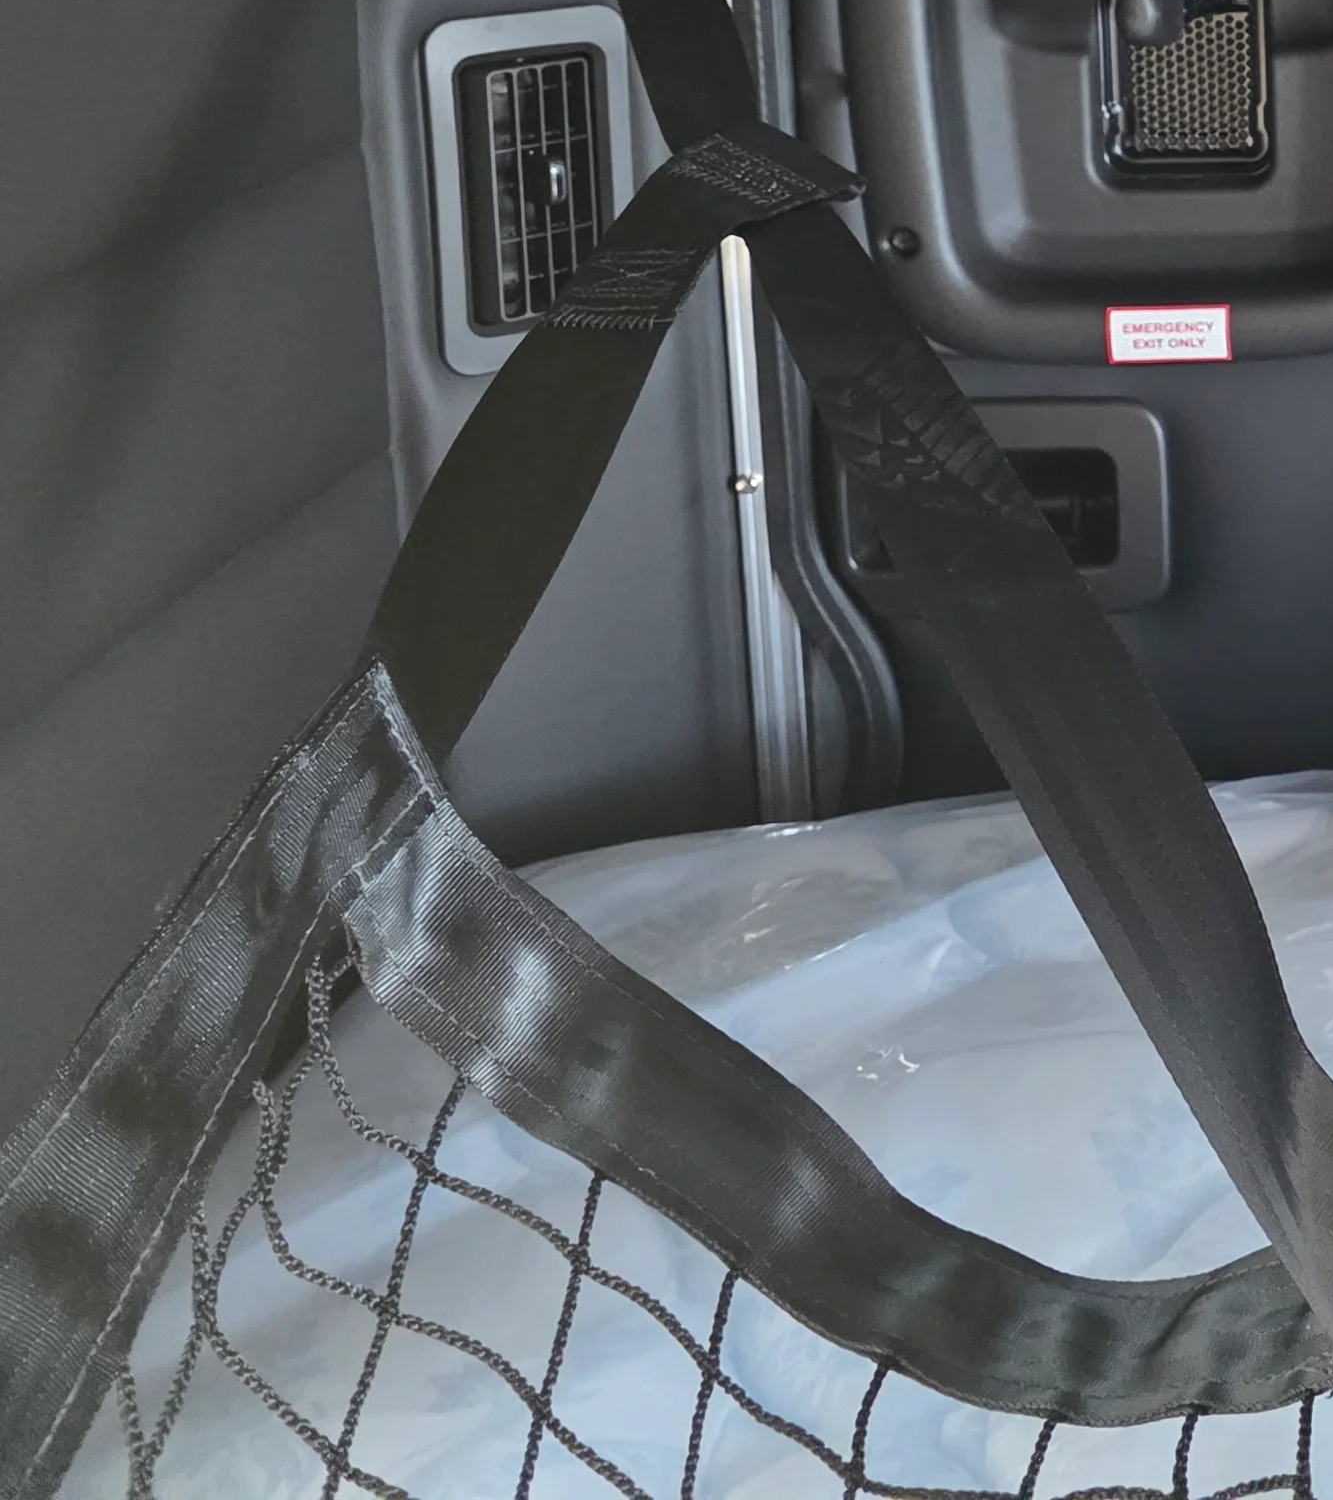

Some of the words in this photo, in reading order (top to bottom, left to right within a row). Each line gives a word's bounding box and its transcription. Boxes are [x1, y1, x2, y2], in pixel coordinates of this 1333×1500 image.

[1122, 321, 1214, 334] EMERGENCY
[1132, 338, 1163, 350] EXIT
[1168, 337, 1206, 349] ONLY
